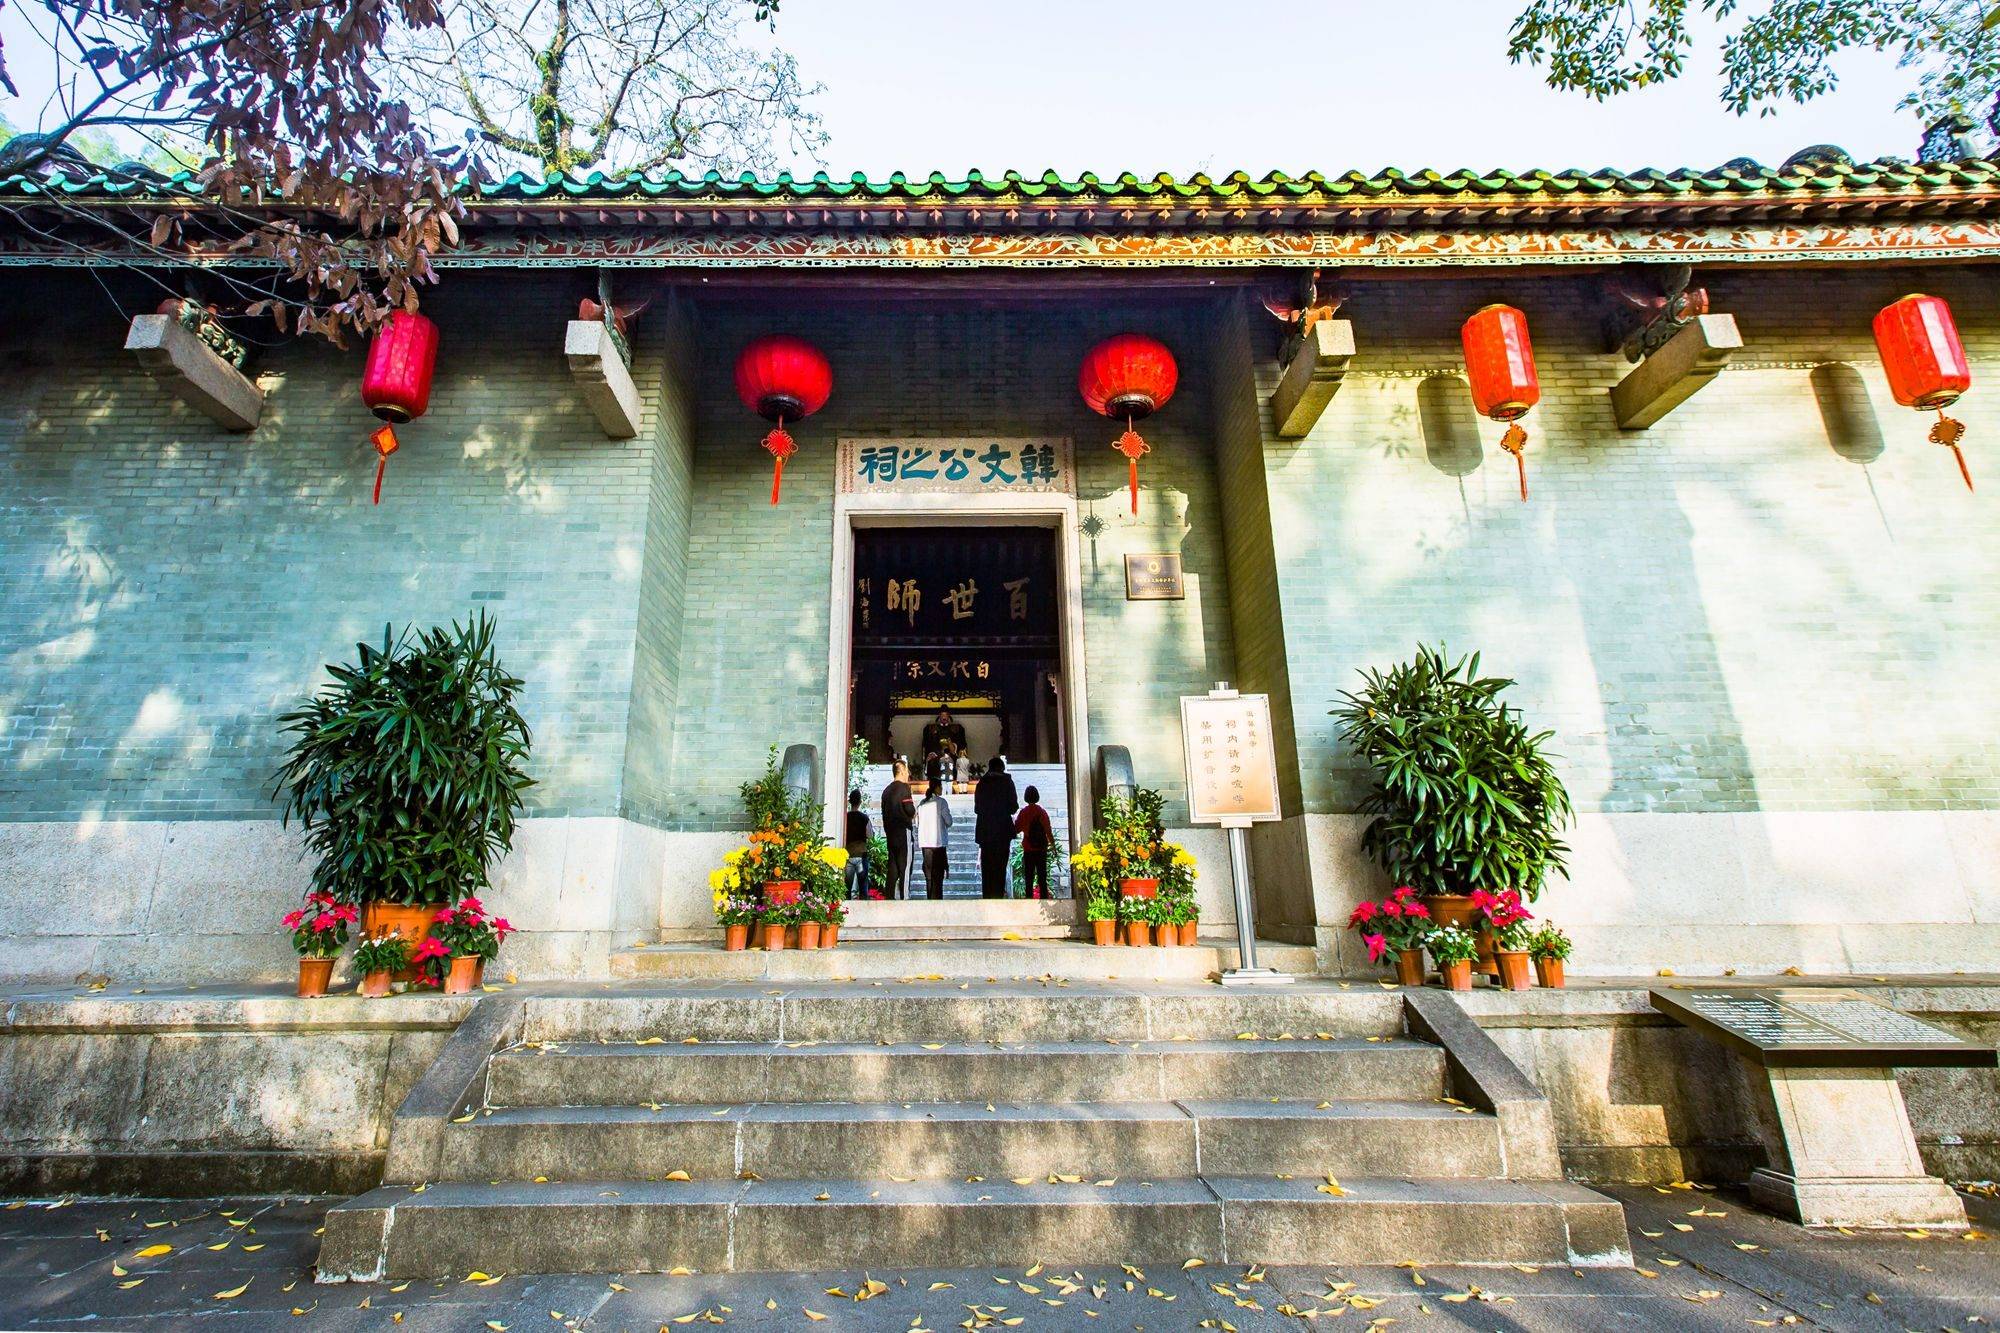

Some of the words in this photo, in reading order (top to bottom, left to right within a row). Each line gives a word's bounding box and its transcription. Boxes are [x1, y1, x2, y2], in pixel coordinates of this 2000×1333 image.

[858, 443, 1060, 484] 韓文公之祠
[886, 576, 1031, 628] 百世師
